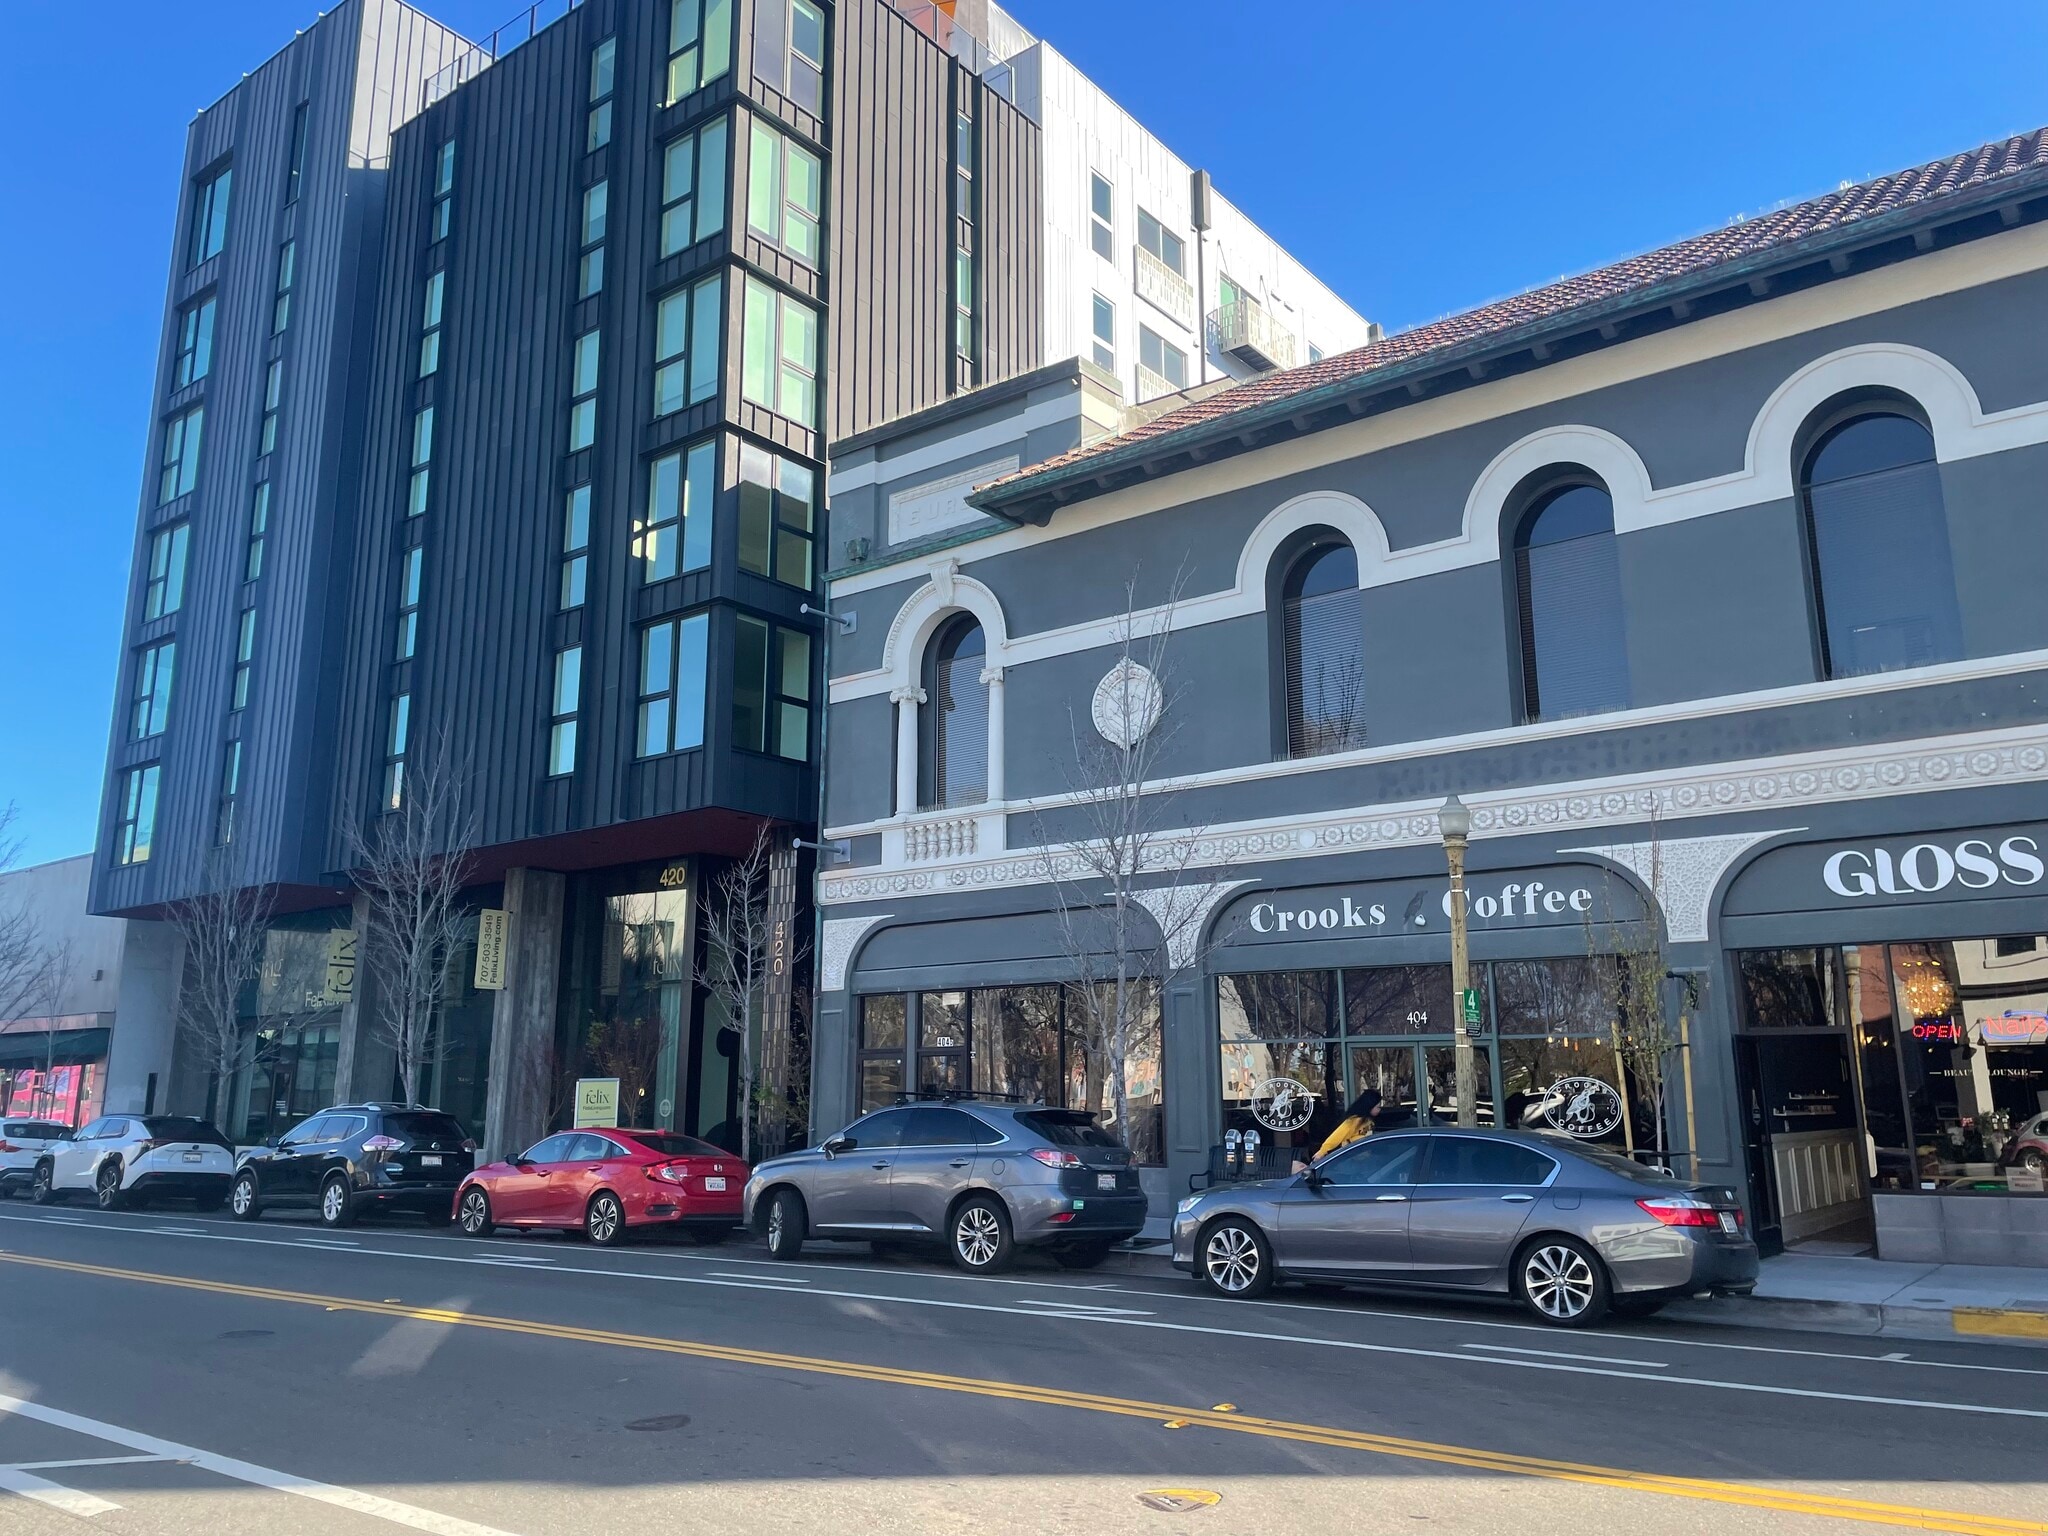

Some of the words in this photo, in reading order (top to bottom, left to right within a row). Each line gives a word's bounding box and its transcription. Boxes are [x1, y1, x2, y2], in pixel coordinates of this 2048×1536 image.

[660, 866, 685, 887] 420
[1823, 836, 2045, 897] GLOSS
[1249, 896, 1387, 934] Crooks
[1441, 881, 1593, 919] Coffee
[480, 914, 494, 983] 707-503-3549
[489, 915, 502, 984] FelixLiving.com
[773, 921, 785, 976] 420
[327, 936, 358, 994] felix
[1467, 989, 1477, 1010] 4
[1406, 1010, 1428, 1025] 404
[1985, 1014, 2048, 1036] Nails
[1912, 1025, 1962, 1039] OPEN
[585, 1089, 610, 1104] felix
[1262, 1113, 1305, 1127] COFFEE
[1558, 1117, 1612, 1133] COFFEE
